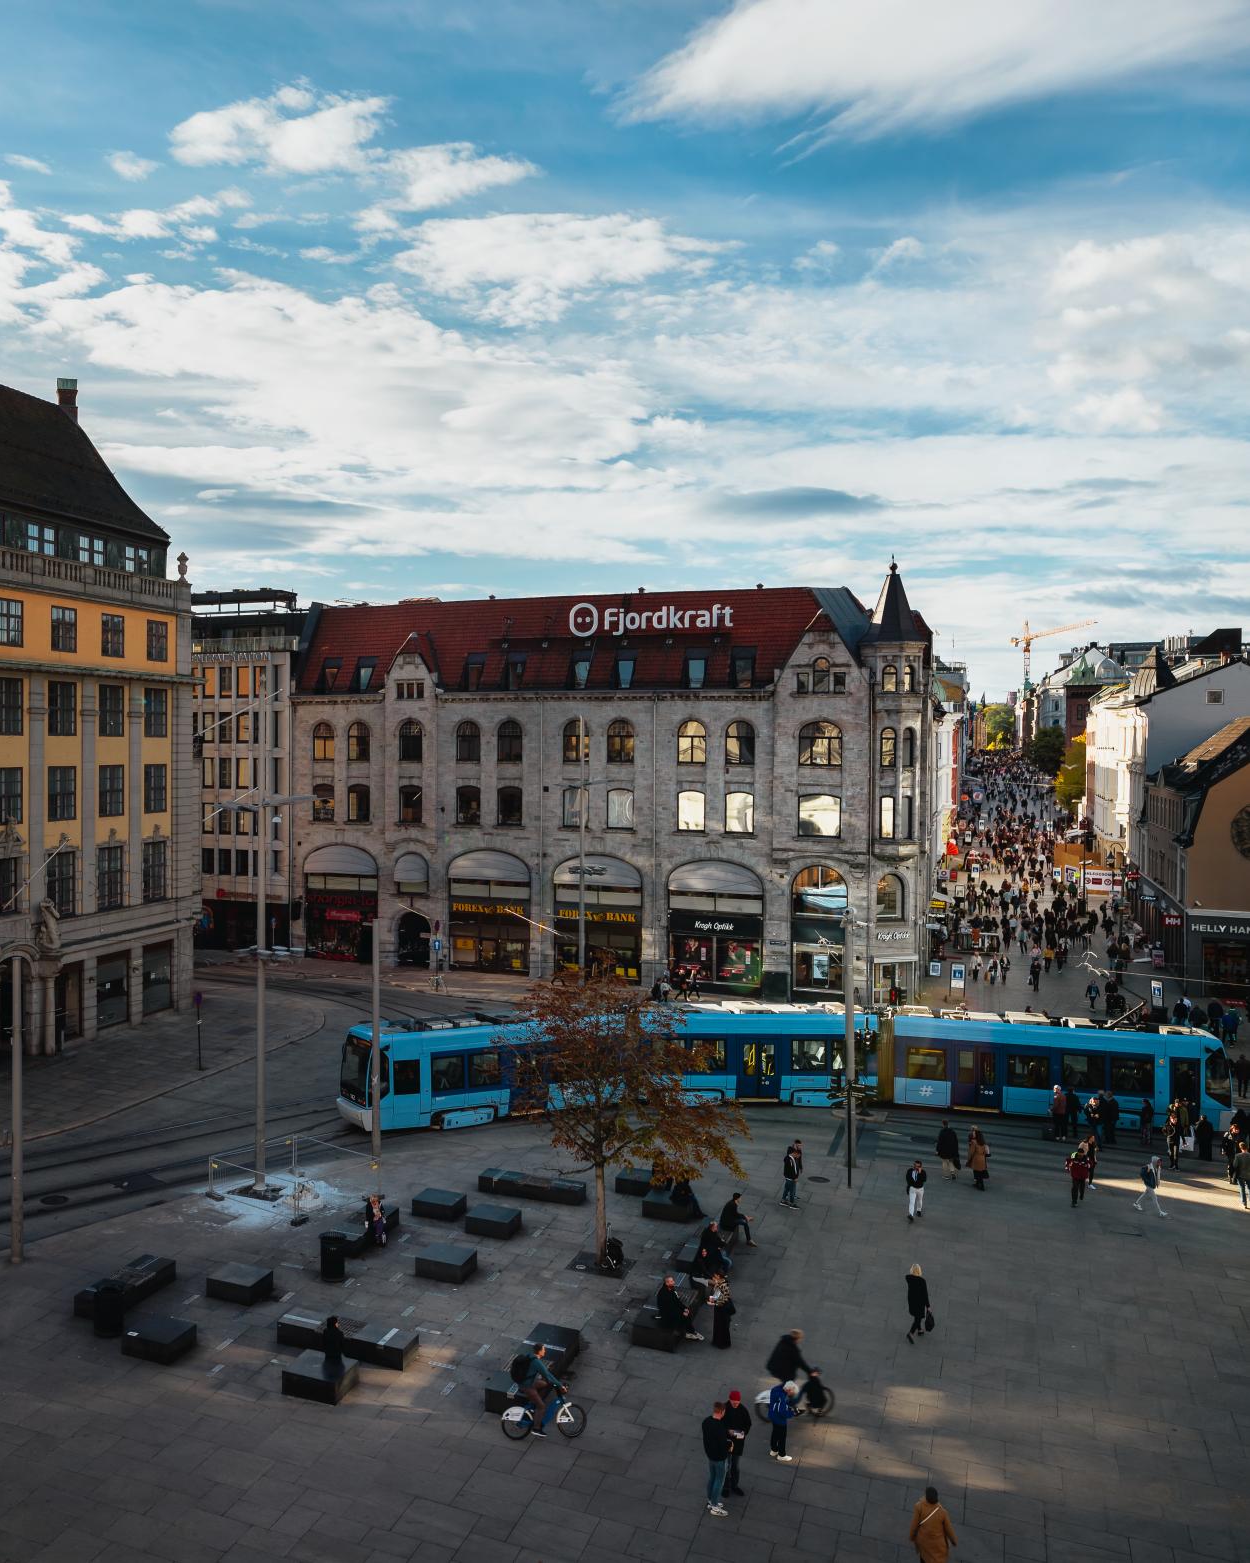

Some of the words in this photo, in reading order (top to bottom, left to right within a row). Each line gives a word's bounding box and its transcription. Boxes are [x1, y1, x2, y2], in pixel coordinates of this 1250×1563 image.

[604, 603, 734, 636] Fjordkraft
[452, 902, 484, 912] FOREX
[496, 904, 524, 914] BANK
[558, 909, 592, 920] FORX
[605, 911, 636, 923] BANK
[1165, 917, 1181, 925] HH
[694, 920, 713, 931] Krogh
[713, 921, 734, 931] Optikk
[1191, 923, 1227, 933] HELLY
